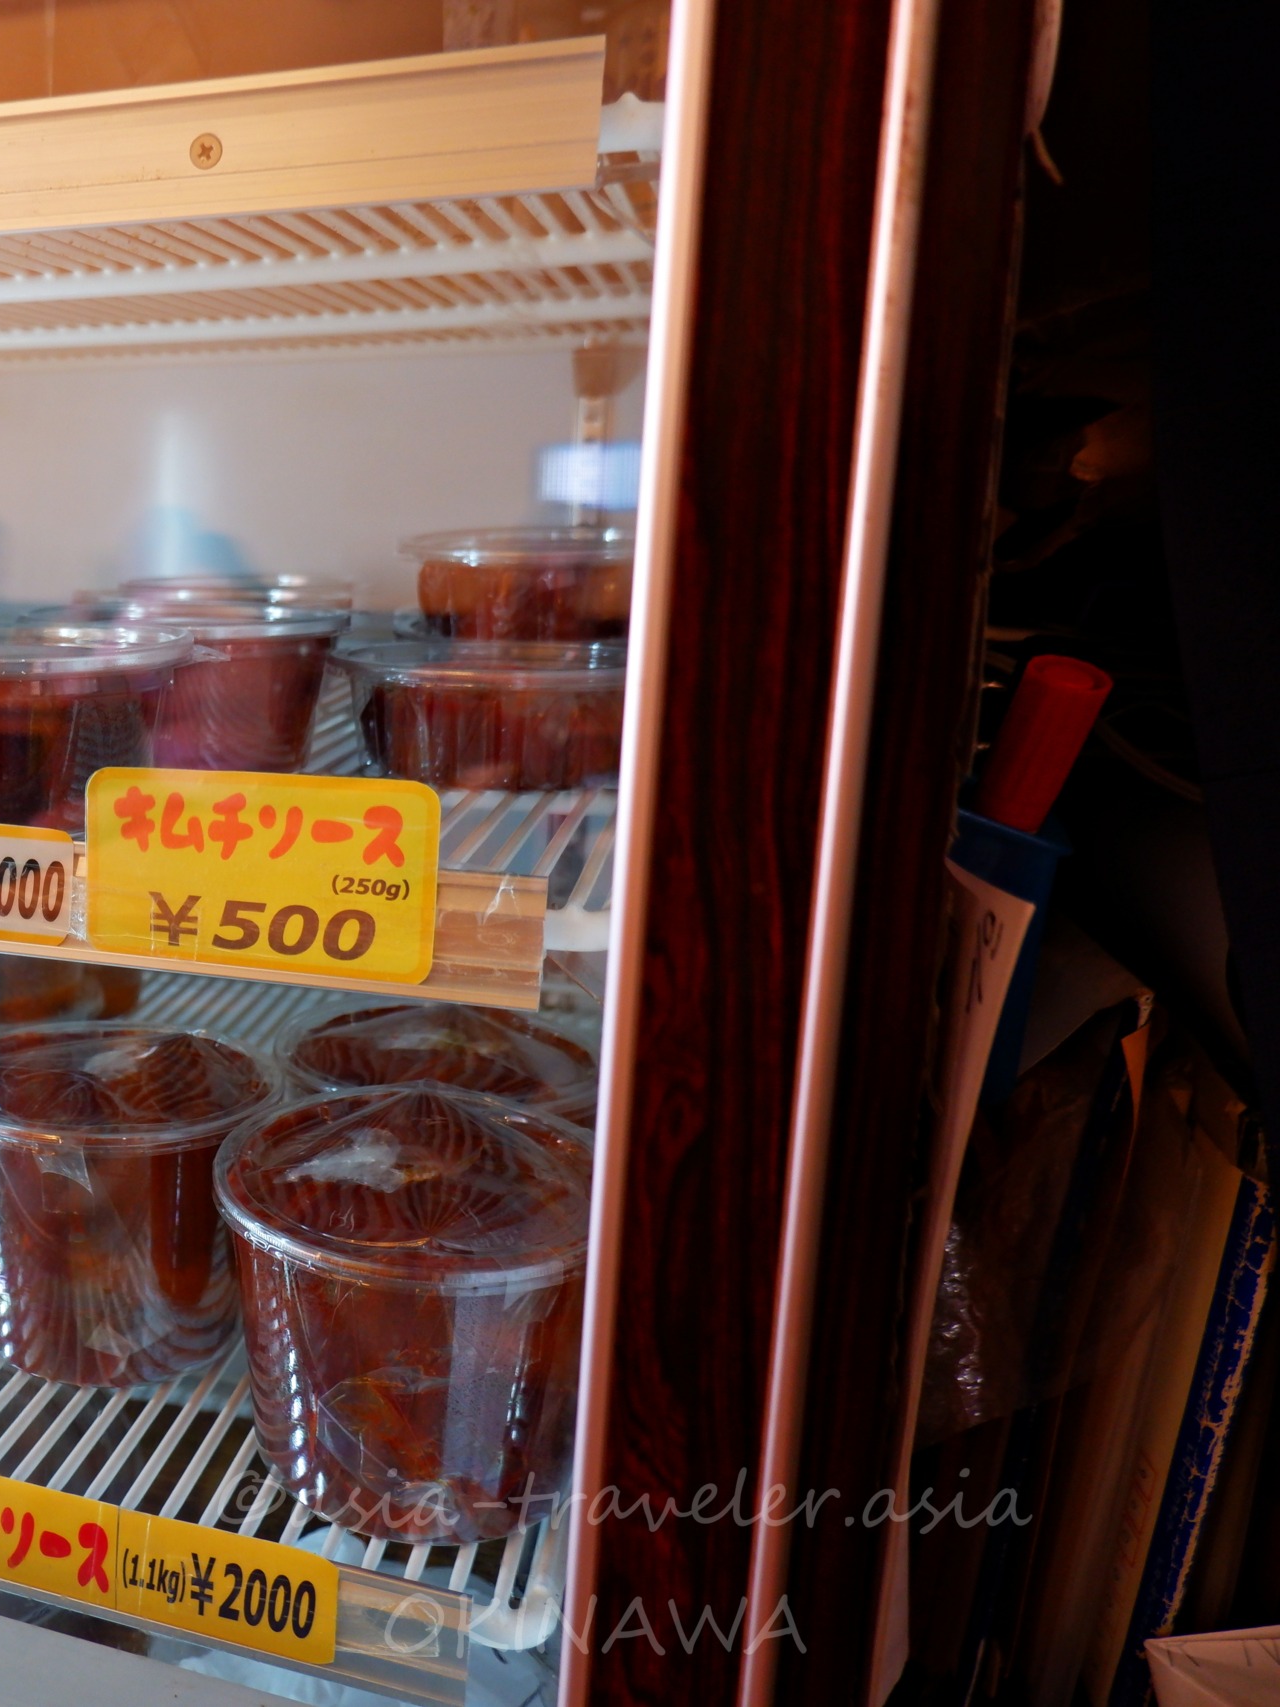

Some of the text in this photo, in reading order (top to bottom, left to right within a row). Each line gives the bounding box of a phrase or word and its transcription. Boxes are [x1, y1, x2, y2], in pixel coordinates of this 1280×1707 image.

[114, 786, 405, 868] キムチソース
[331, 874, 409, 902] (250g)
[123, 1548, 185, 1604] (1.1kg)
[191, 1553, 316, 1640] ¥2000
